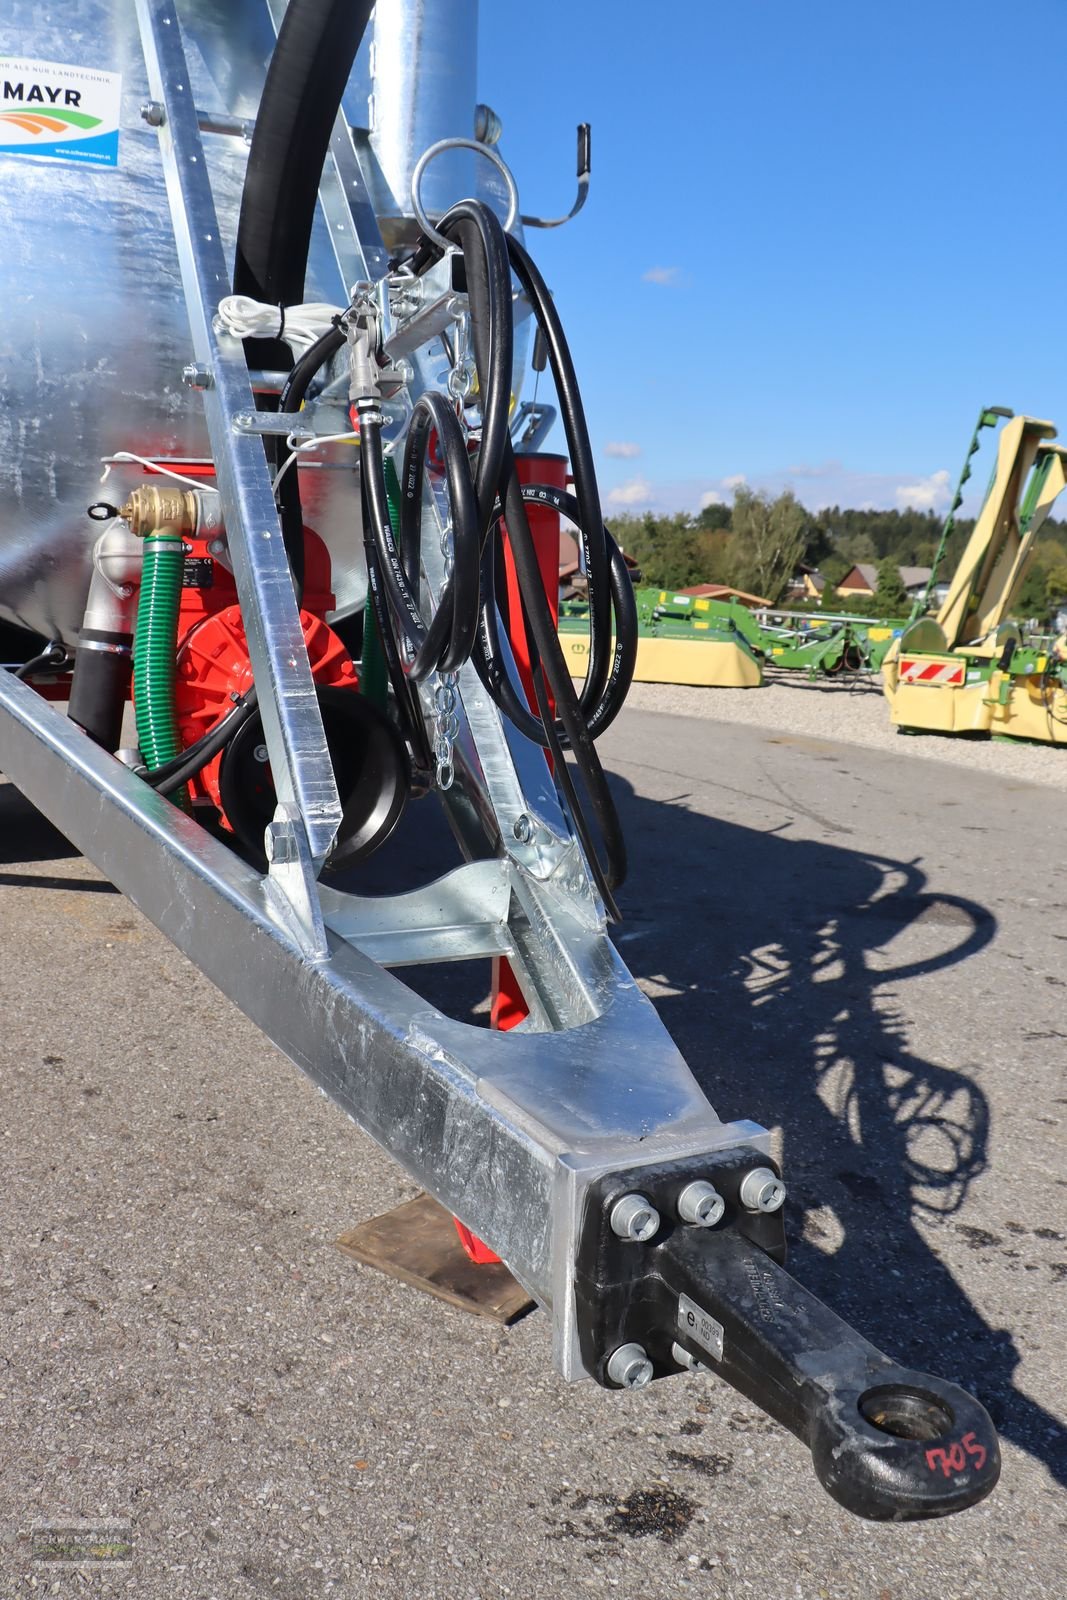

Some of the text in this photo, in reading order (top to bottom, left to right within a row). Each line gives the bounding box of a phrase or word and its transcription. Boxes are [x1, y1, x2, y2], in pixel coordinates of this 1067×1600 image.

[0, 81, 82, 107] MAYR
[384, 524, 395, 553] WABCO
[391, 558, 400, 569] DIN
[369, 567, 378, 592] WABCO
[395, 570, 406, 589] 74310
[410, 612, 421, 624] 2022
[613, 654, 622, 674] 2022
